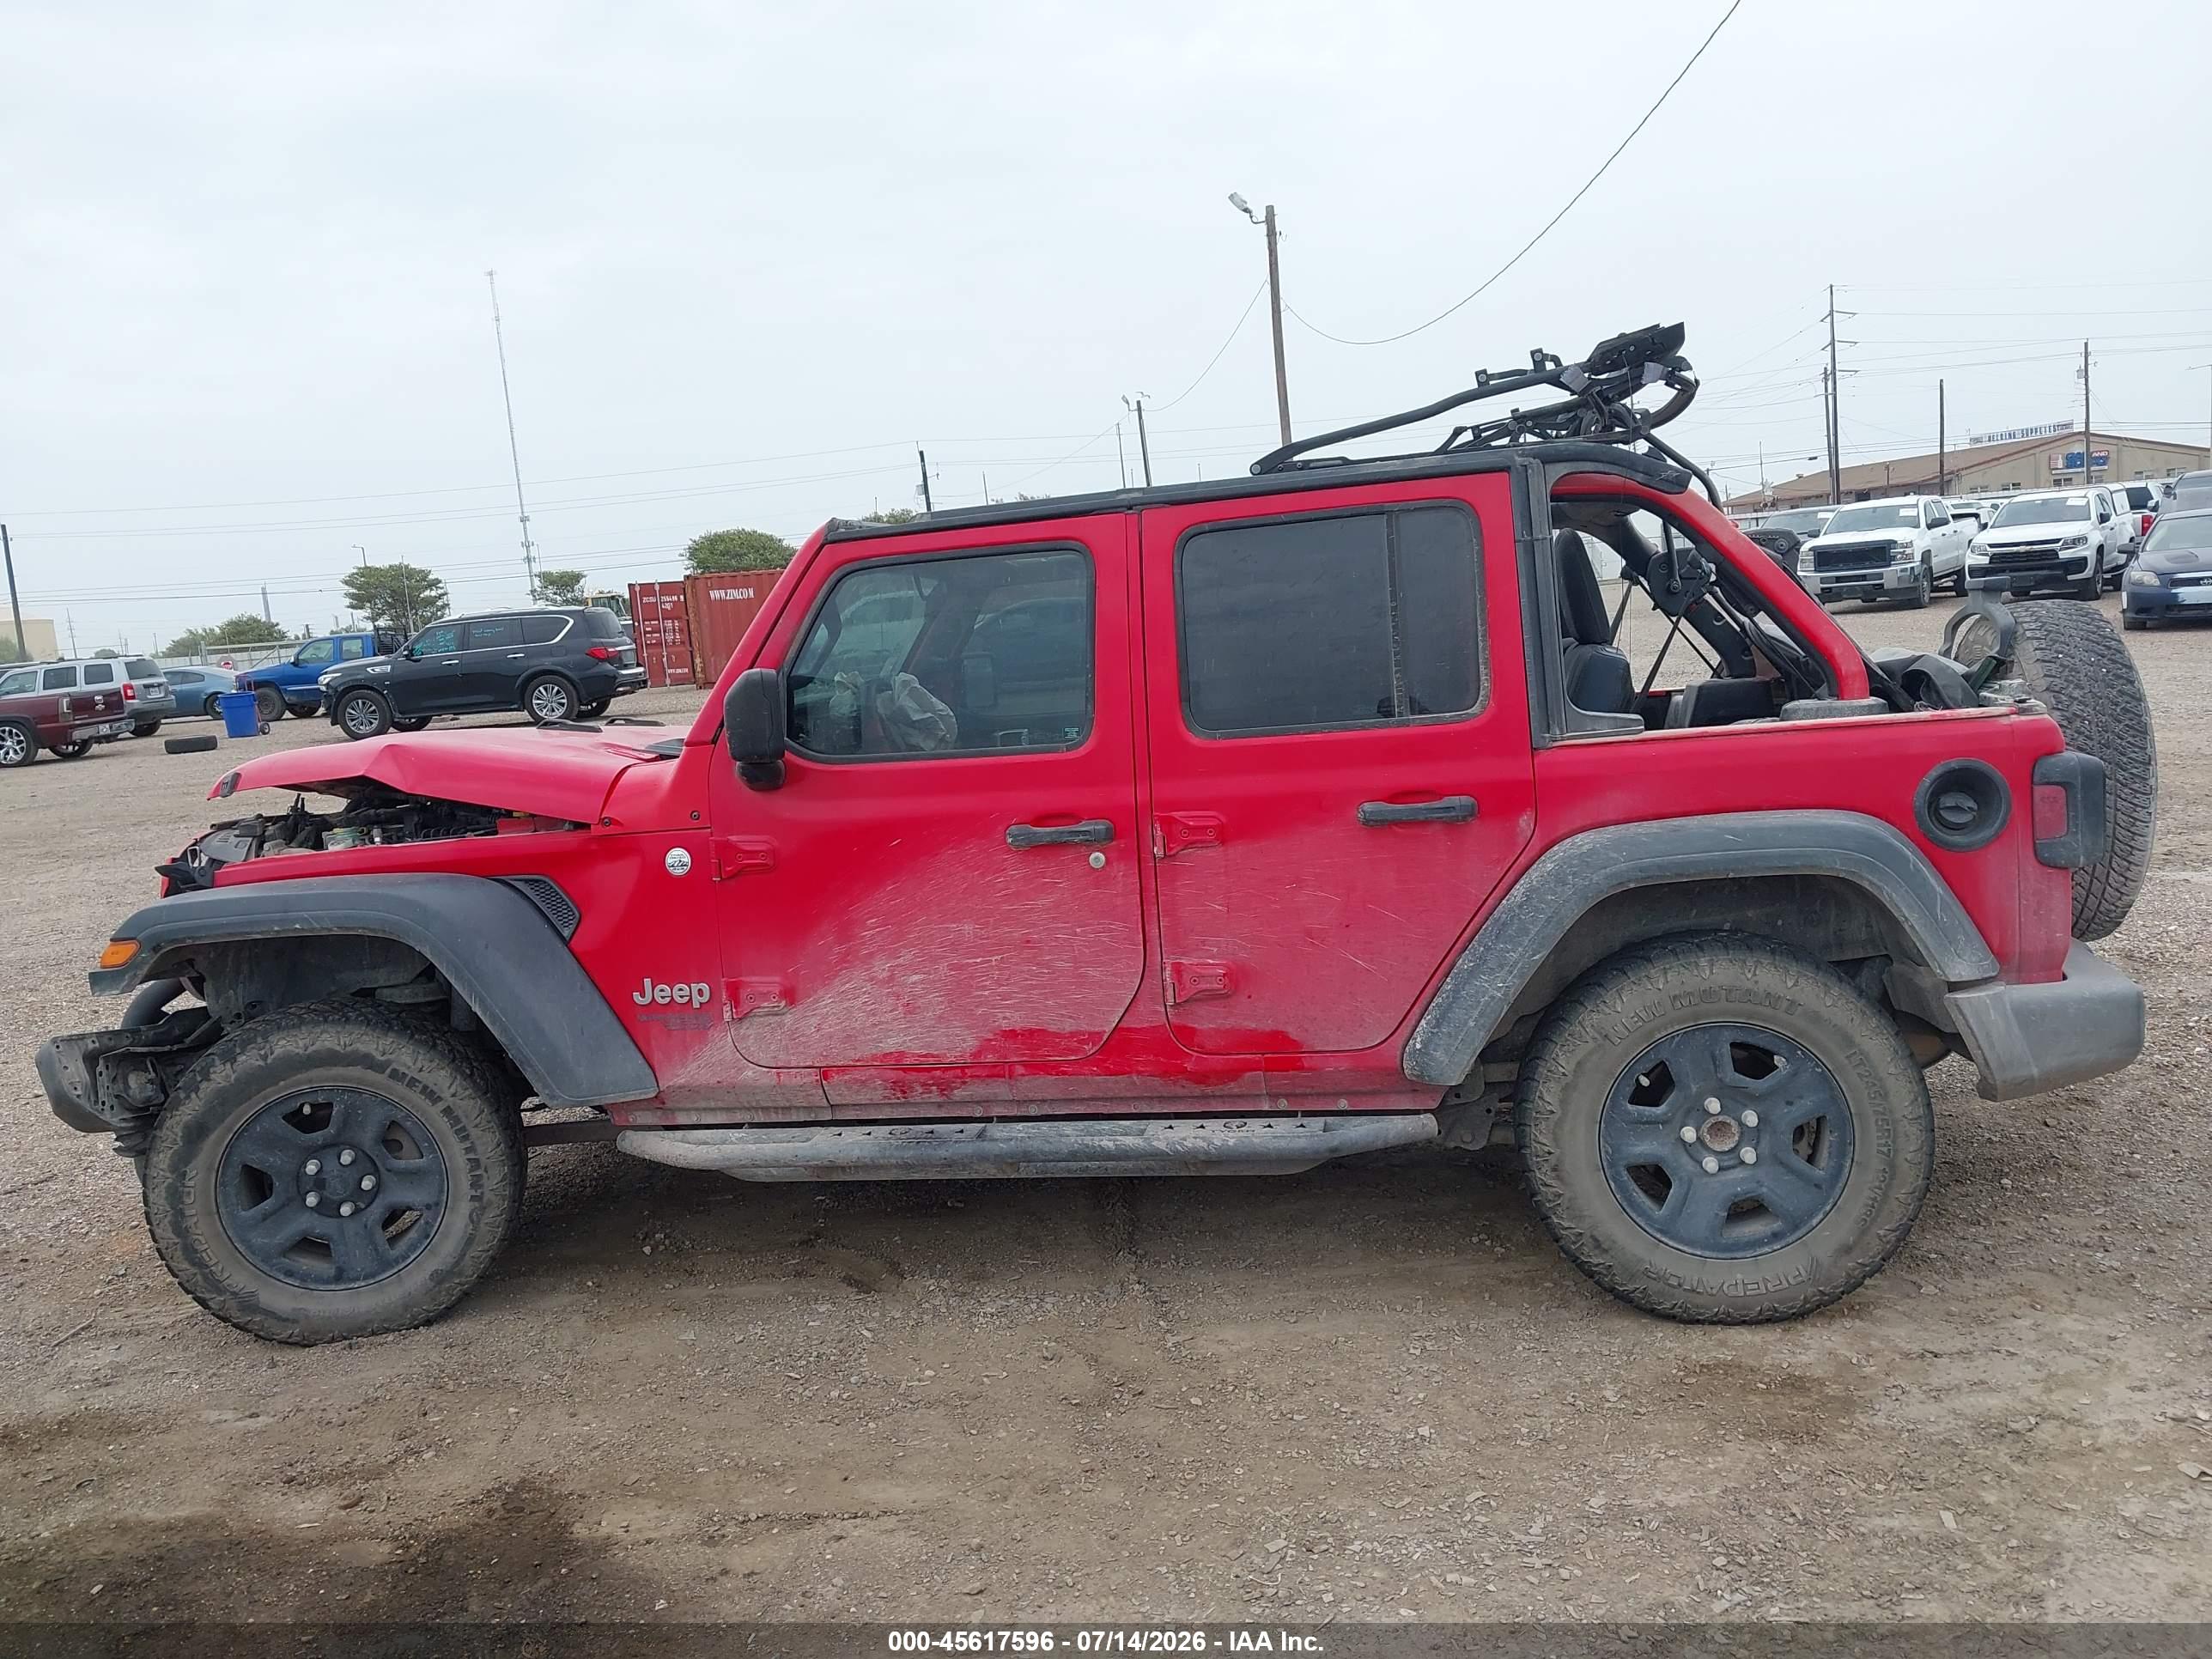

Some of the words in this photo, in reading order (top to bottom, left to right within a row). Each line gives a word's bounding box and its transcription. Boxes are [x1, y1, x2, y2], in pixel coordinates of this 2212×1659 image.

[708, 587, 755, 601] WWW.ZIM.COM
[633, 978, 711, 1009] Jeep
[1604, 1000, 1667, 1046] NEW
[1668, 986, 1805, 1016] MUTANT
[387, 1067, 444, 1106] NEW
[439, 1104, 484, 1203] MUTANT
[1641, 1259, 1809, 1298] PREDATOR
